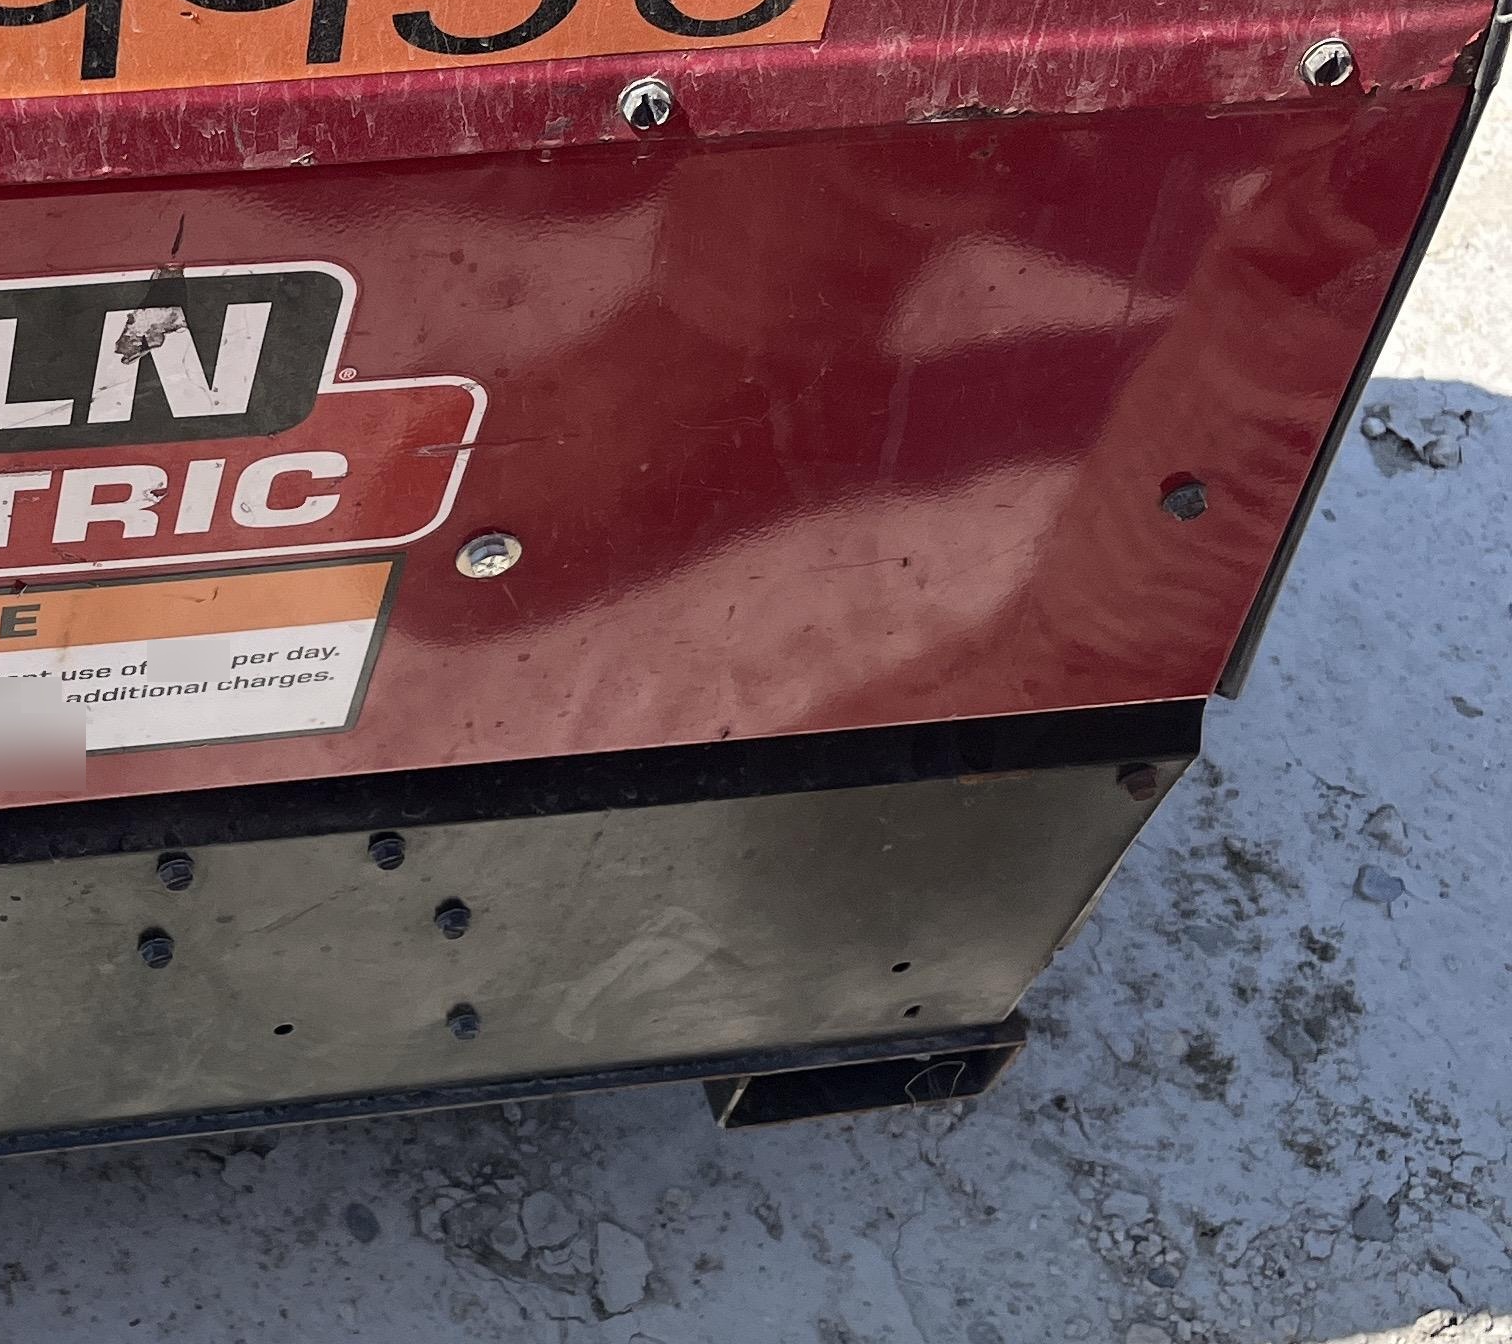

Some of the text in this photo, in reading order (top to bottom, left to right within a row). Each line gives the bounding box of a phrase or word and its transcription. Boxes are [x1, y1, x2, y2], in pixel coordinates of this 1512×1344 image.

[61, 665, 112, 681] use
[121, 659, 148, 678] of
[230, 648, 280, 670] per
[286, 643, 342, 664] day.
[65, 681, 208, 703] additional
[216, 669, 336, 694] charges.
